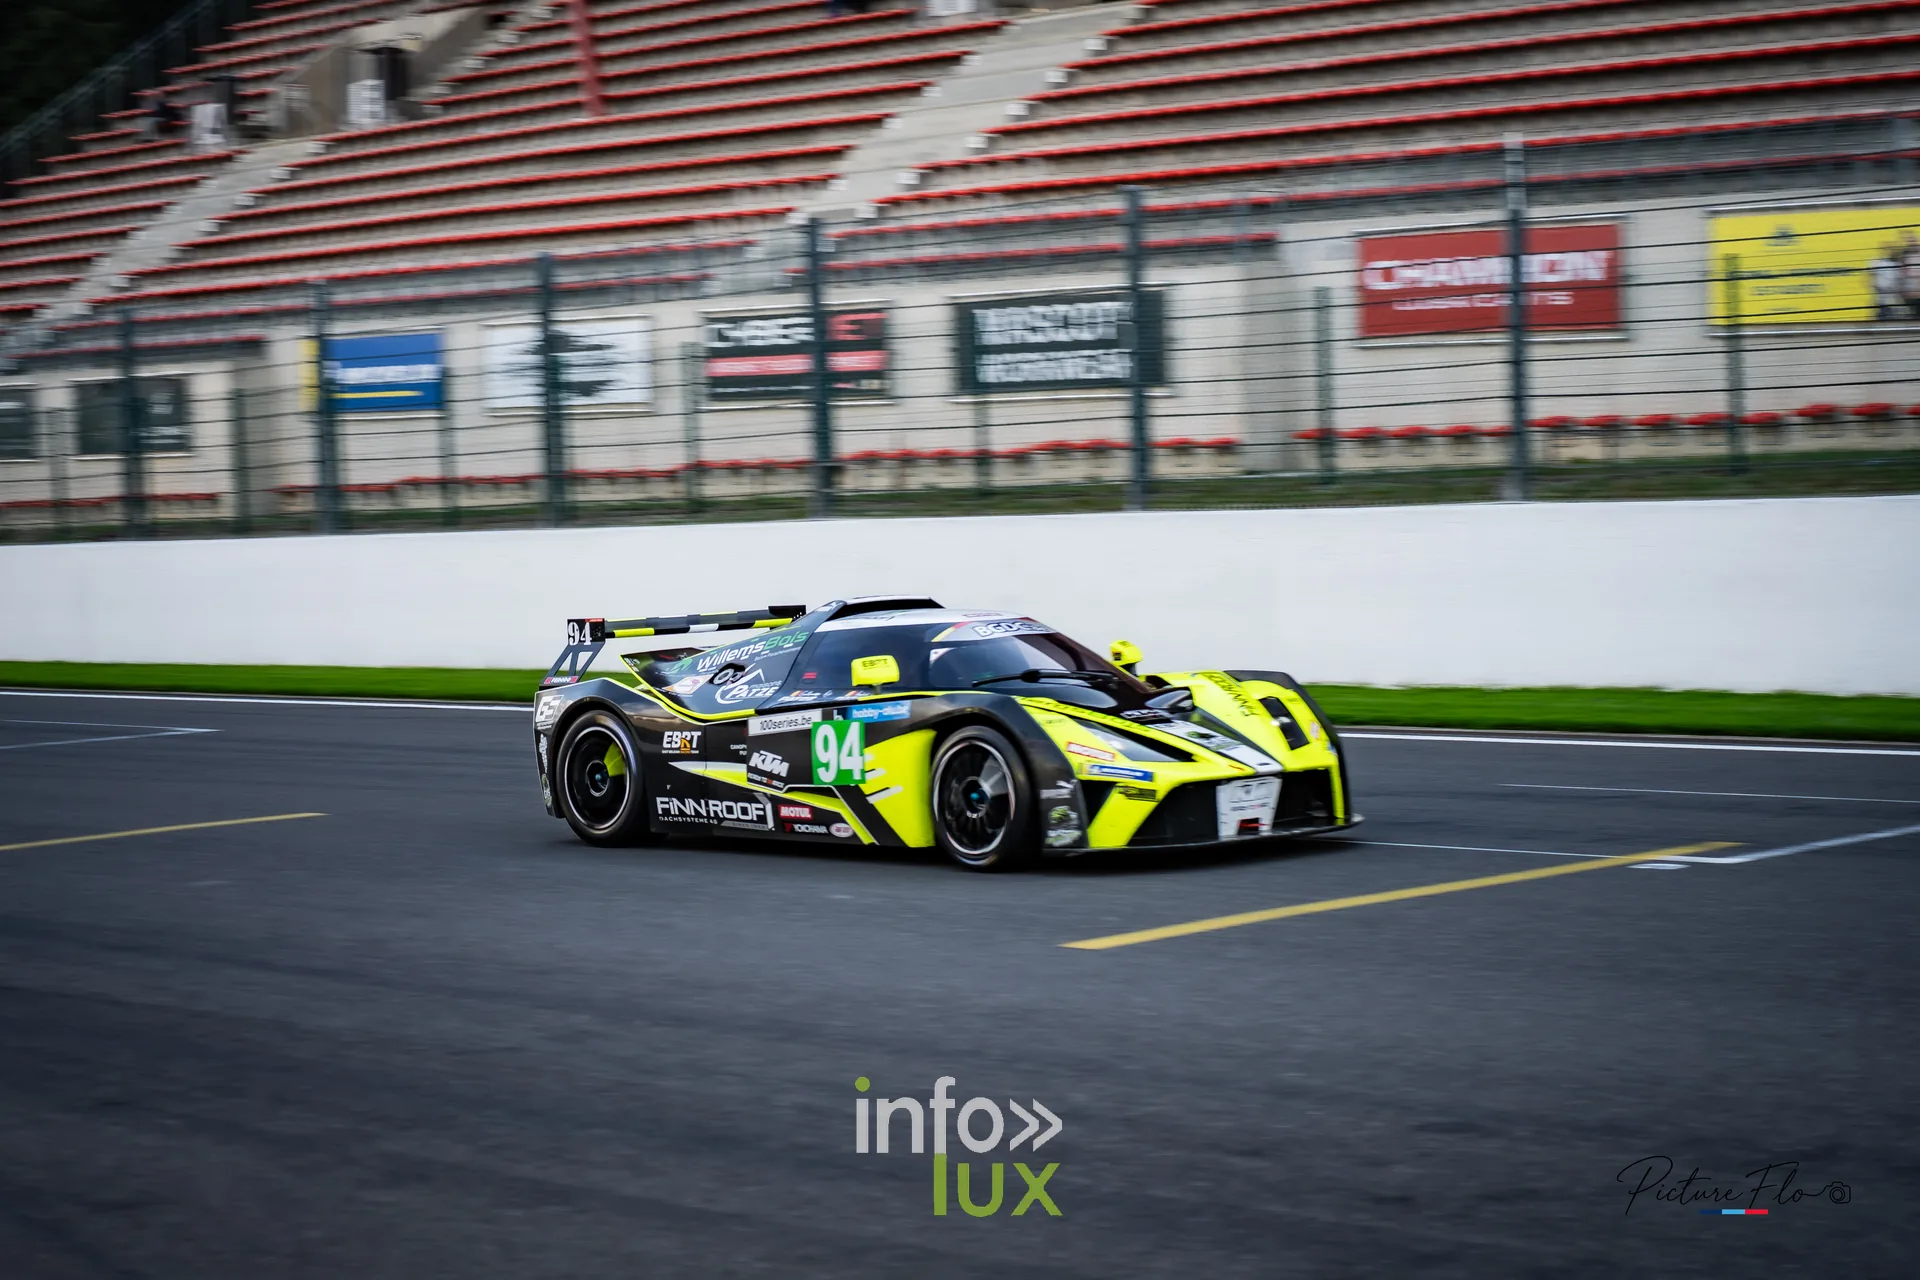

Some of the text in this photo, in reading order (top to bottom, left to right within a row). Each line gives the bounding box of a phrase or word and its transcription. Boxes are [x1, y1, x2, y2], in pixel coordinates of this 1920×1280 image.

[1363, 250, 1613, 290] CHAMION
[567, 621, 593, 646] 94
[759, 716, 812, 731] 100series.be
[748, 750, 790, 777] KTM
[815, 721, 864, 783] 94
[780, 806, 811, 818] MOTUL
